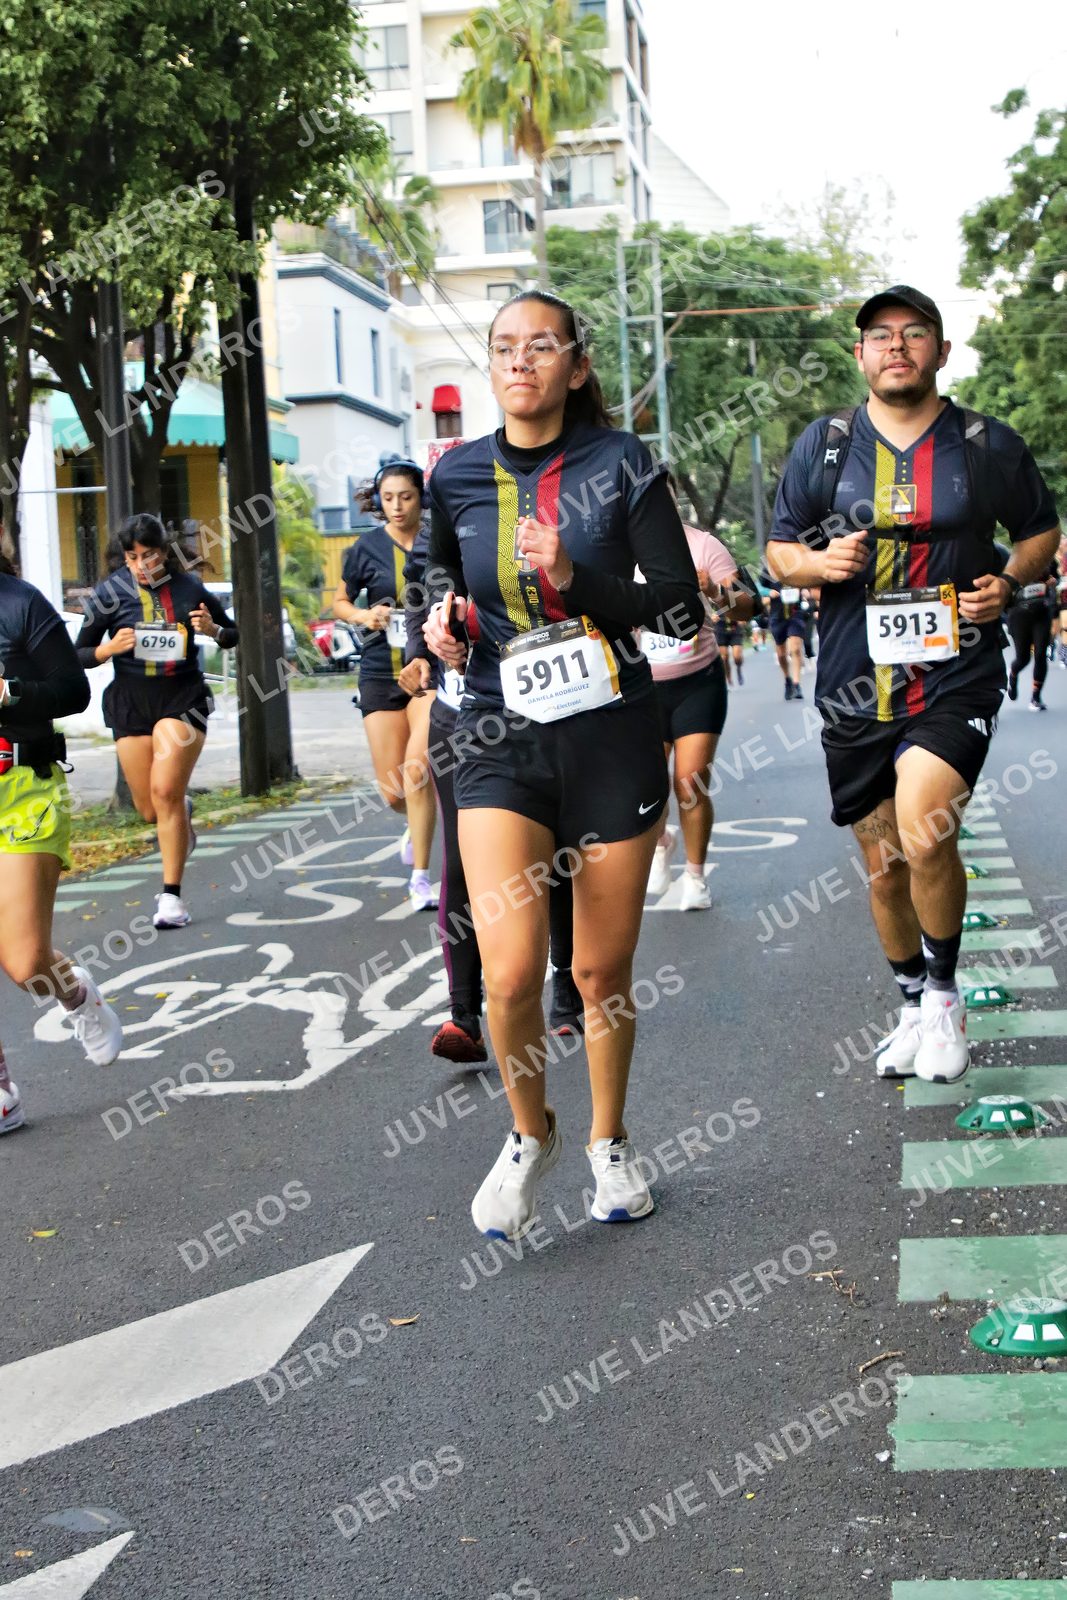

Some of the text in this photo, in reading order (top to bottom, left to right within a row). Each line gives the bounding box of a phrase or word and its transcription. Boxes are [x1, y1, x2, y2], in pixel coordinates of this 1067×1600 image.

[879, 612, 938, 638] 5913
[141, 635, 176, 648] 6796
[515, 649, 589, 696] 5911
[527, 683, 590, 705] DANIELA RODRÍGUEZ
